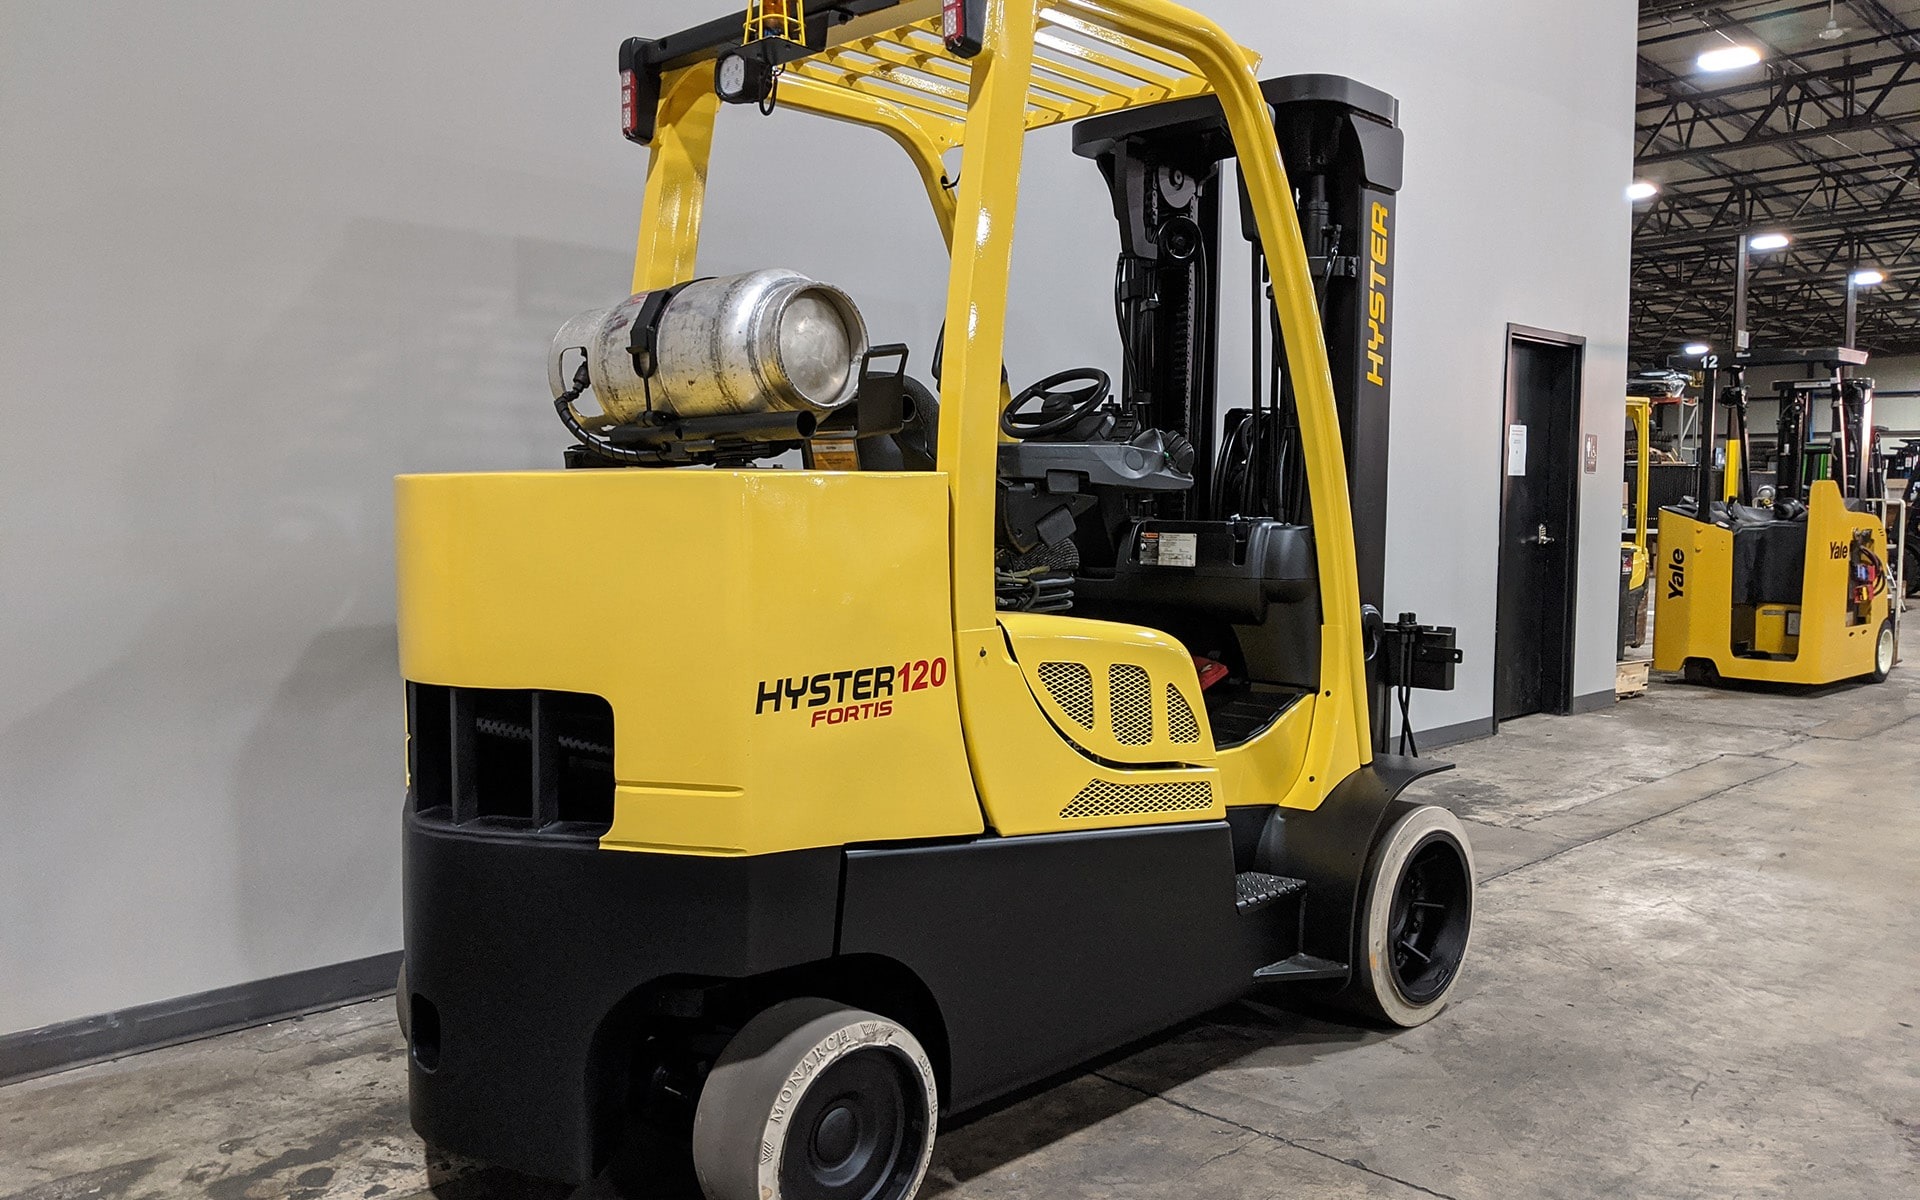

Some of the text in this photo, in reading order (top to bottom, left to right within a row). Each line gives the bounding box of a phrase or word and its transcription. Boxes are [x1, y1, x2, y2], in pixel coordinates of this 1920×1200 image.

[1366, 202, 1389, 386] HYSTER
[1700, 355, 1718, 369] 12
[1668, 549, 1685, 599] Yale
[1829, 541, 1847, 559] Yale
[755, 657, 946, 715] HYSTER 120
[811, 700, 892, 727] FORTIS
[770, 1029, 850, 1125] MONARCH
